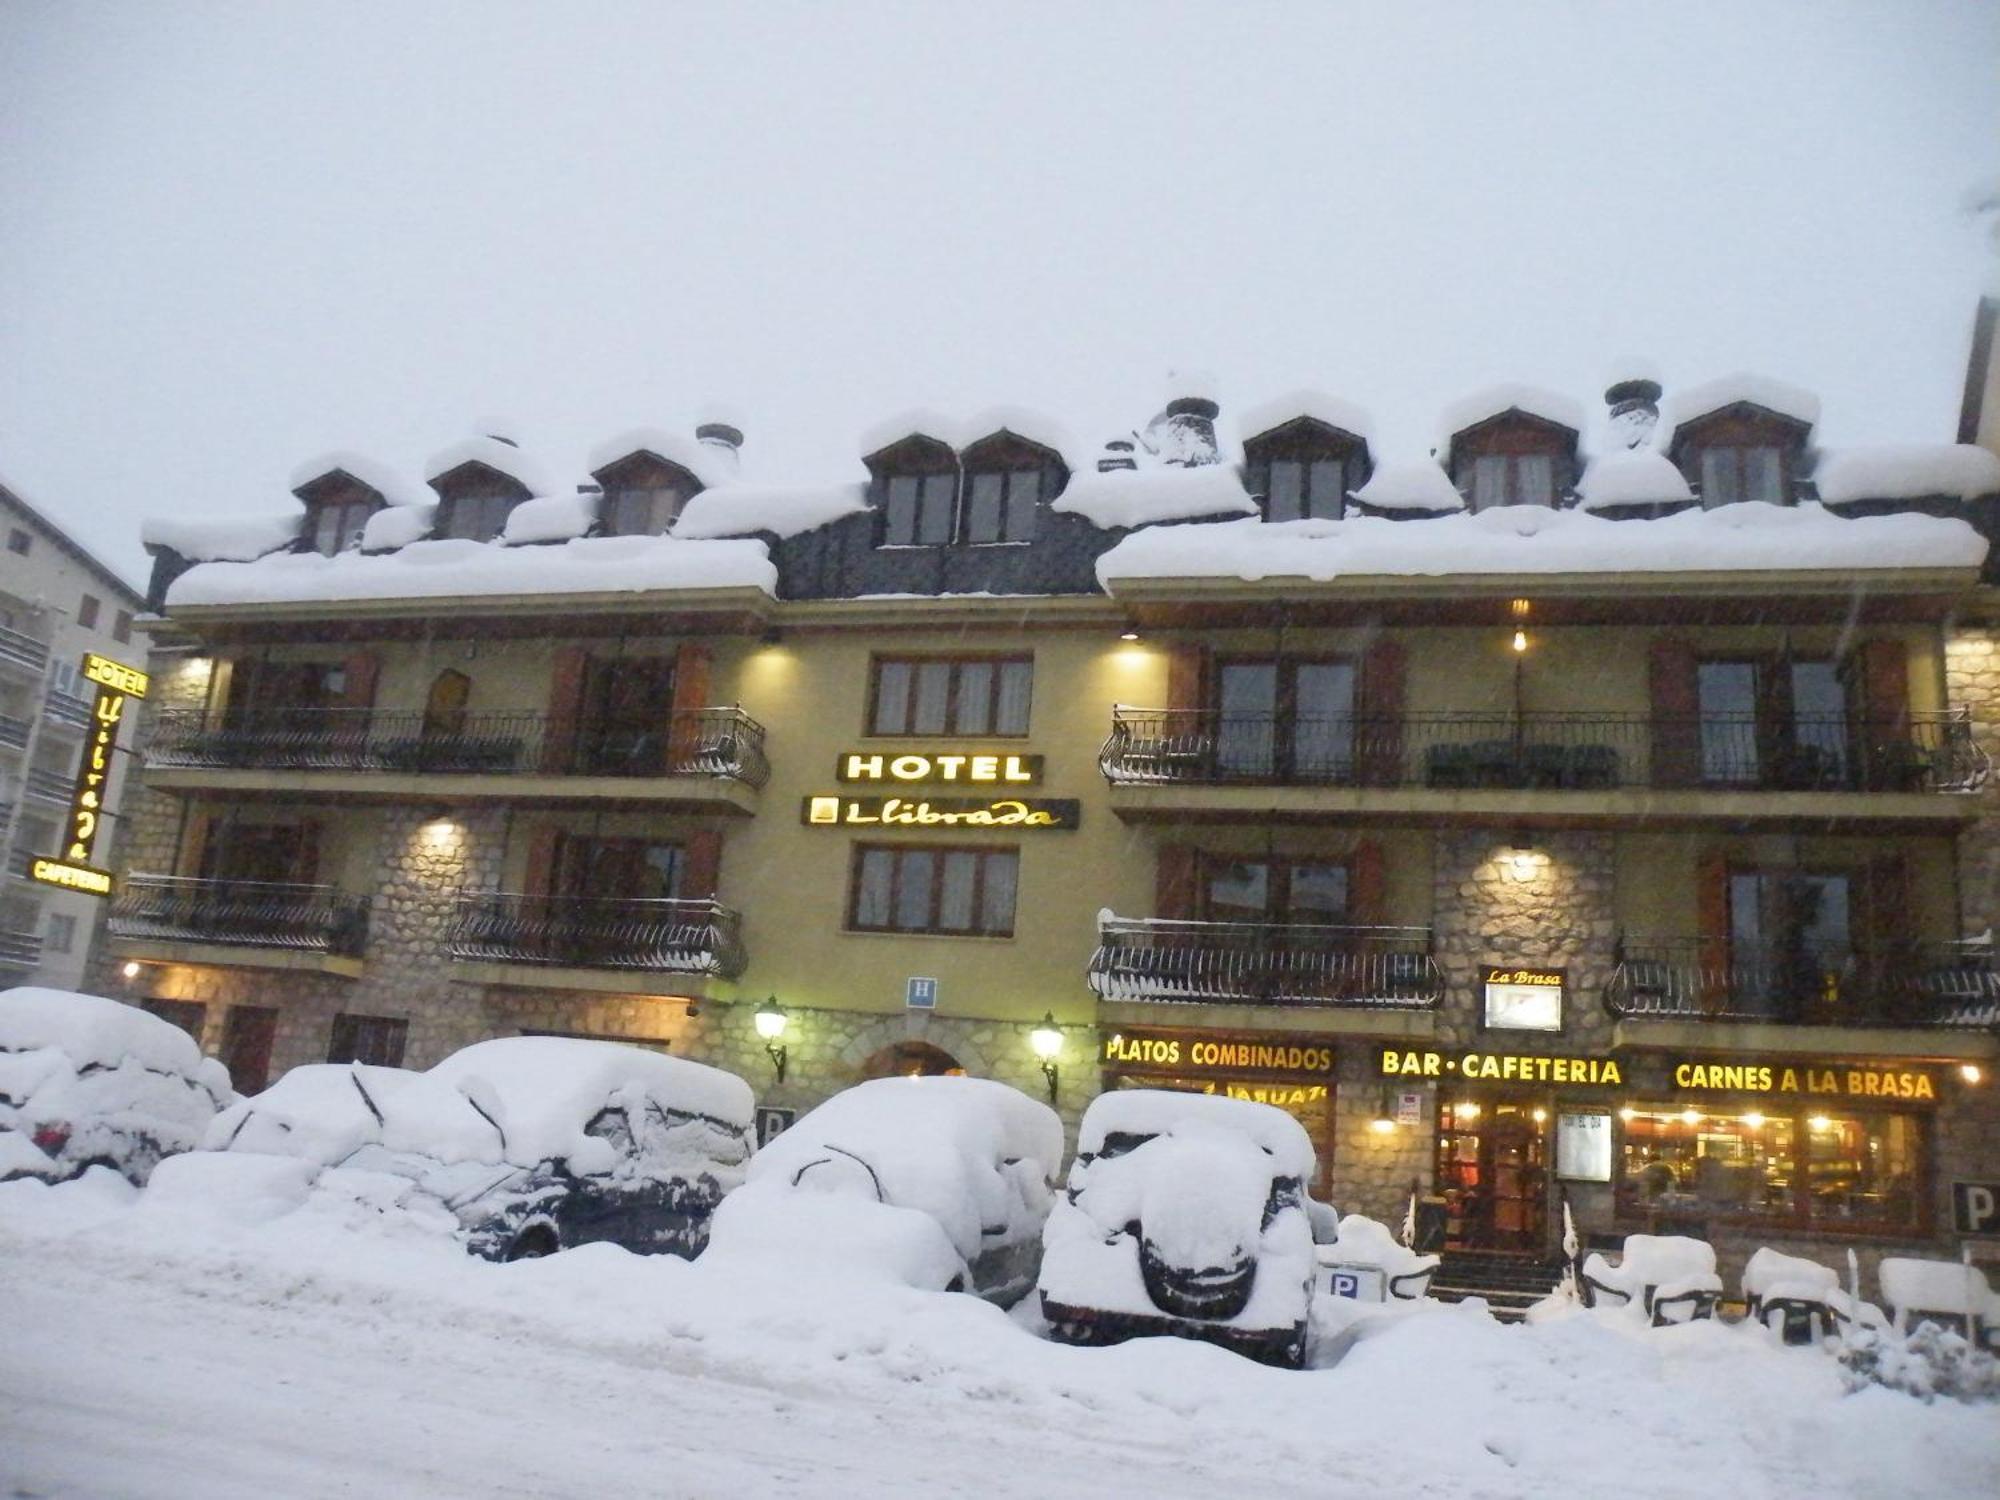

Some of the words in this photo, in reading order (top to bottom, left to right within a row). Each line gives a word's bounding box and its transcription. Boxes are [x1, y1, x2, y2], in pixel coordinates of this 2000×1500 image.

[86, 655, 148, 698] HOTEL
[847, 755, 1031, 780] HOTEL
[846, 798, 1061, 825] Llibrada
[915, 981, 929, 997] H
[1486, 970, 1510, 984] La
[1514, 971, 1562, 985] Brasa
[1106, 1040, 1180, 1063] PLATOS
[1191, 1042, 1331, 1070] COMBINADOS
[1382, 1051, 1440, 1076] BAR
[1462, 1054, 1621, 1084] CAFETERIA
[1676, 1064, 1772, 1091] CARNES
[1780, 1069, 1798, 1092] A
[1807, 1070, 1838, 1093] LA
[1848, 1071, 1934, 1099] BRASA
[1967, 1186, 1994, 1231] P
[1341, 1280, 1354, 1297] P
